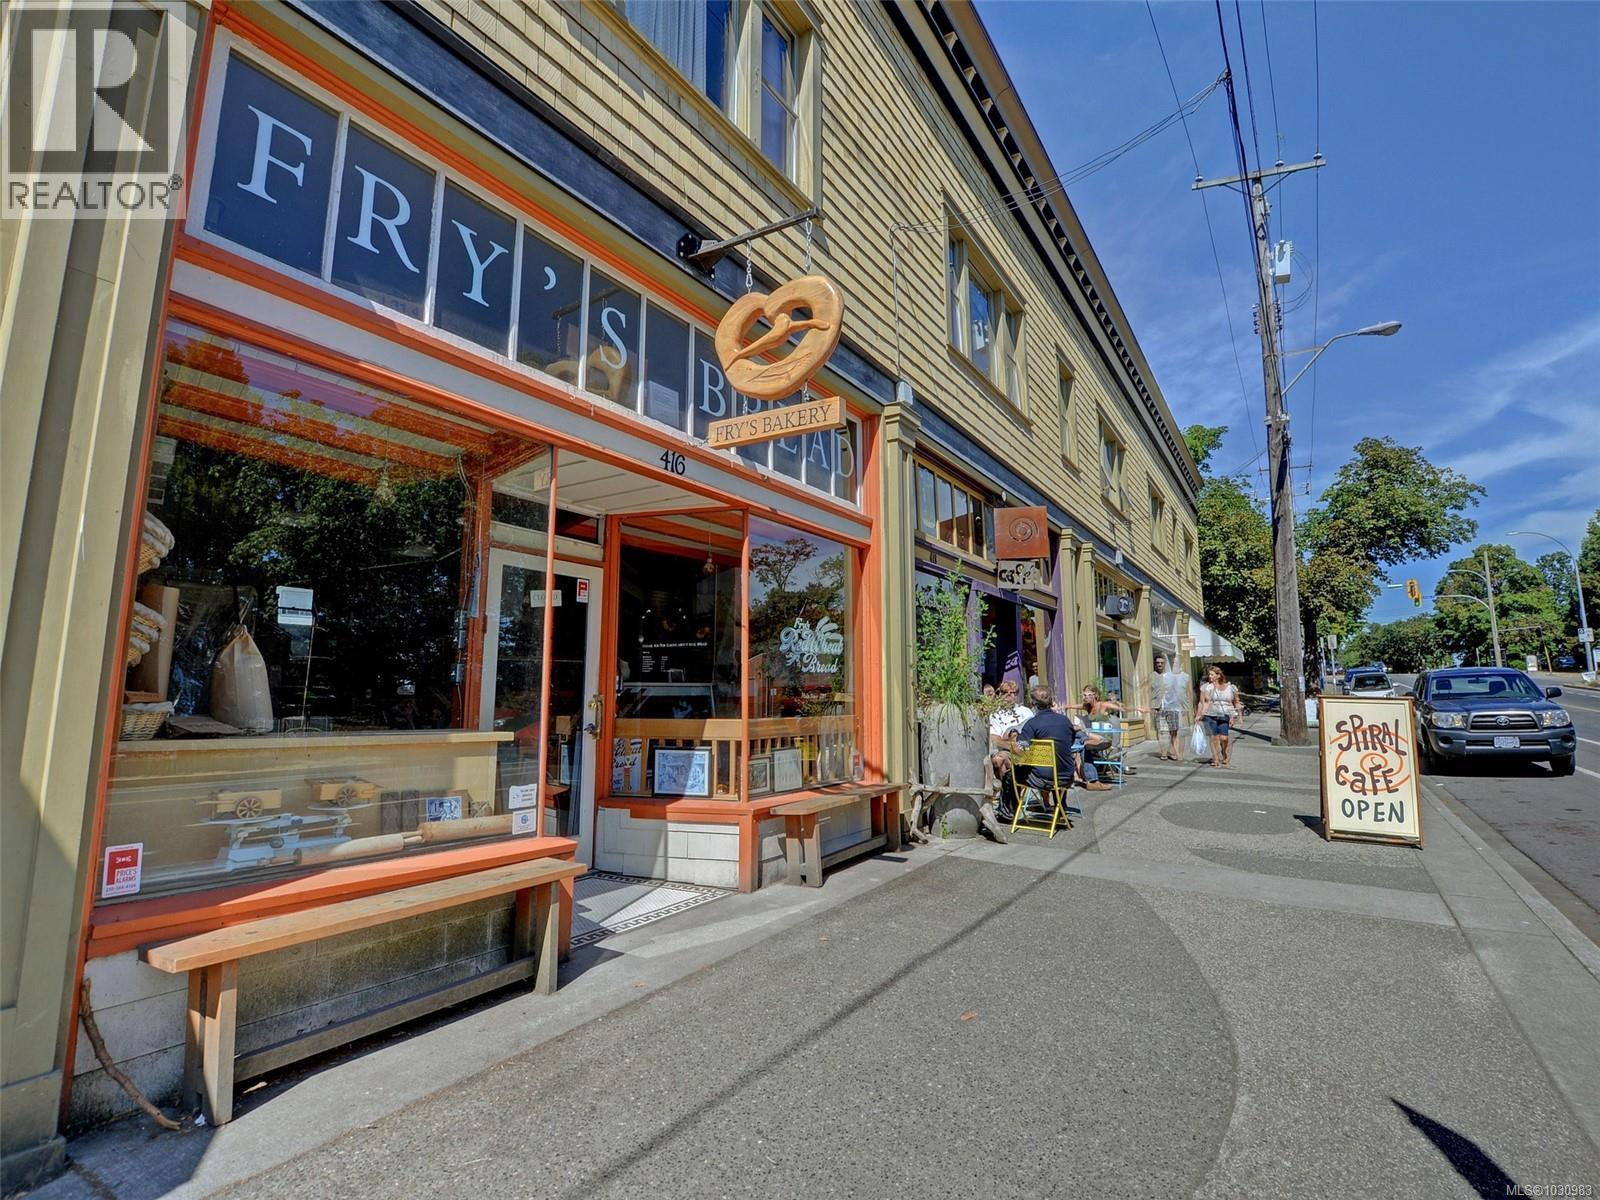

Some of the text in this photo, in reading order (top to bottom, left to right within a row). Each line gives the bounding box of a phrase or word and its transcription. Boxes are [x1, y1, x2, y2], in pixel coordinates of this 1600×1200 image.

[715, 403, 832, 443] FRY'S BAKERY
[660, 449, 686, 475] 416
[1335, 714, 1407, 756] SPIRAL
[1341, 798, 1405, 823] OPEN
